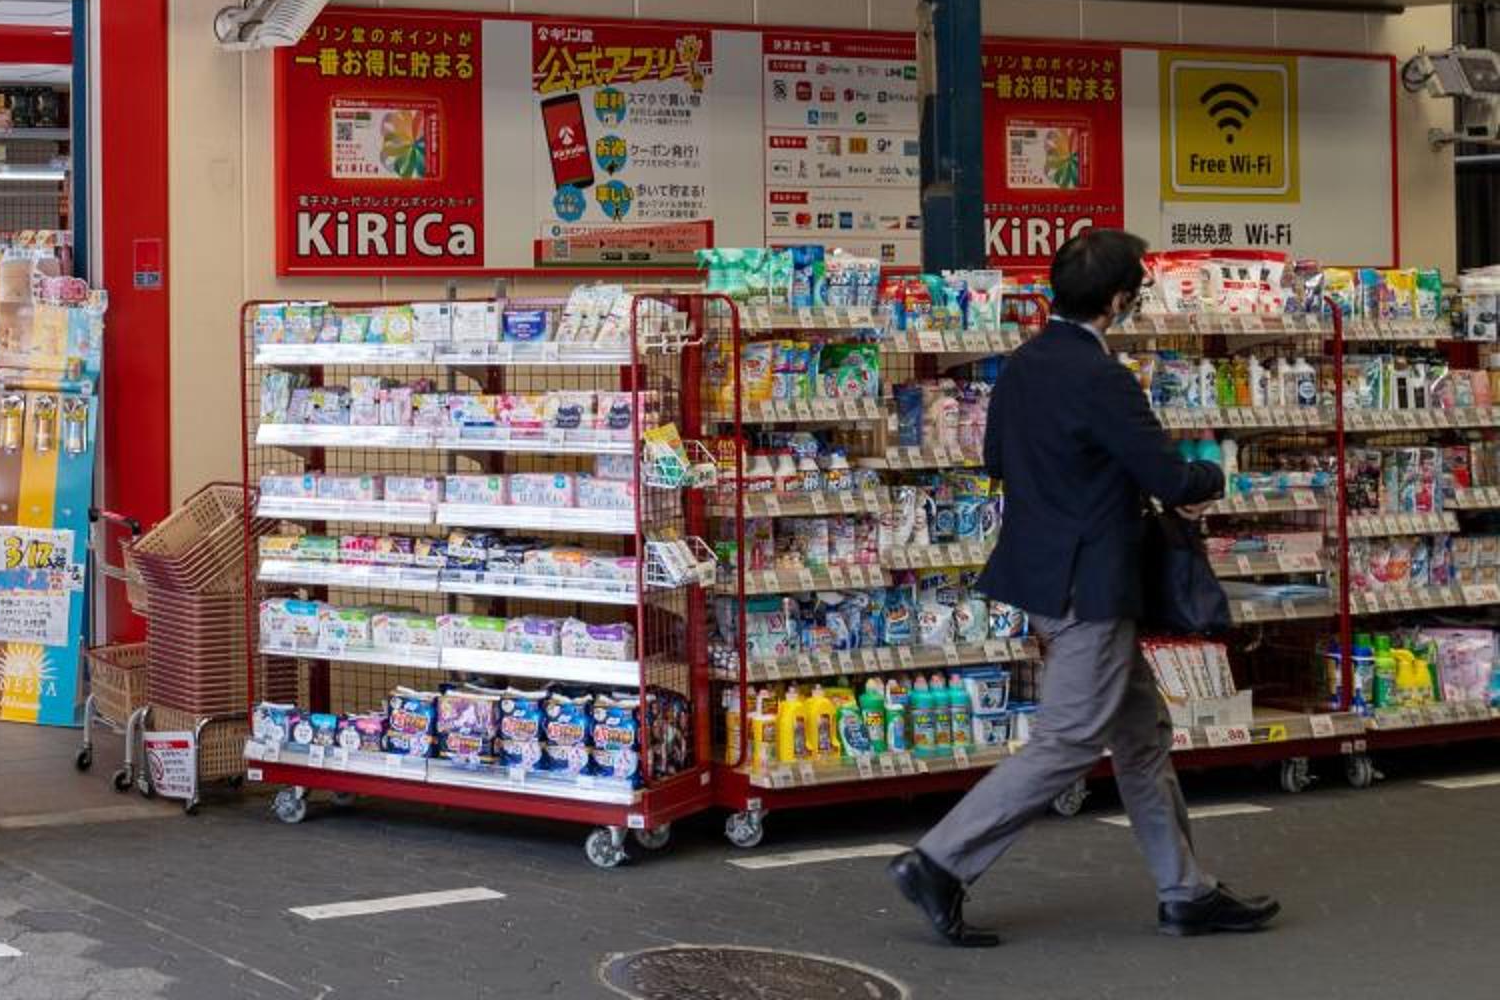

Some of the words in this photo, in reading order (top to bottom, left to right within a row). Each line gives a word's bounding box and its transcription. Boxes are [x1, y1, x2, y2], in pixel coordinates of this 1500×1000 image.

[301, 24, 474, 47] リン堂のポイントが
[295, 47, 474, 80] 一番お得に貯まる
[537, 44, 678, 94] 公式アプリ
[981, 74, 1116, 102] 一番お得に貯まる
[1190, 152, 1226, 174] Free
[1230, 154, 1272, 175] Wi-Fi
[297, 211, 476, 256] KiRiCa
[1172, 221, 1233, 246] 提供免费
[1246, 222, 1292, 247] Wi-Fi
